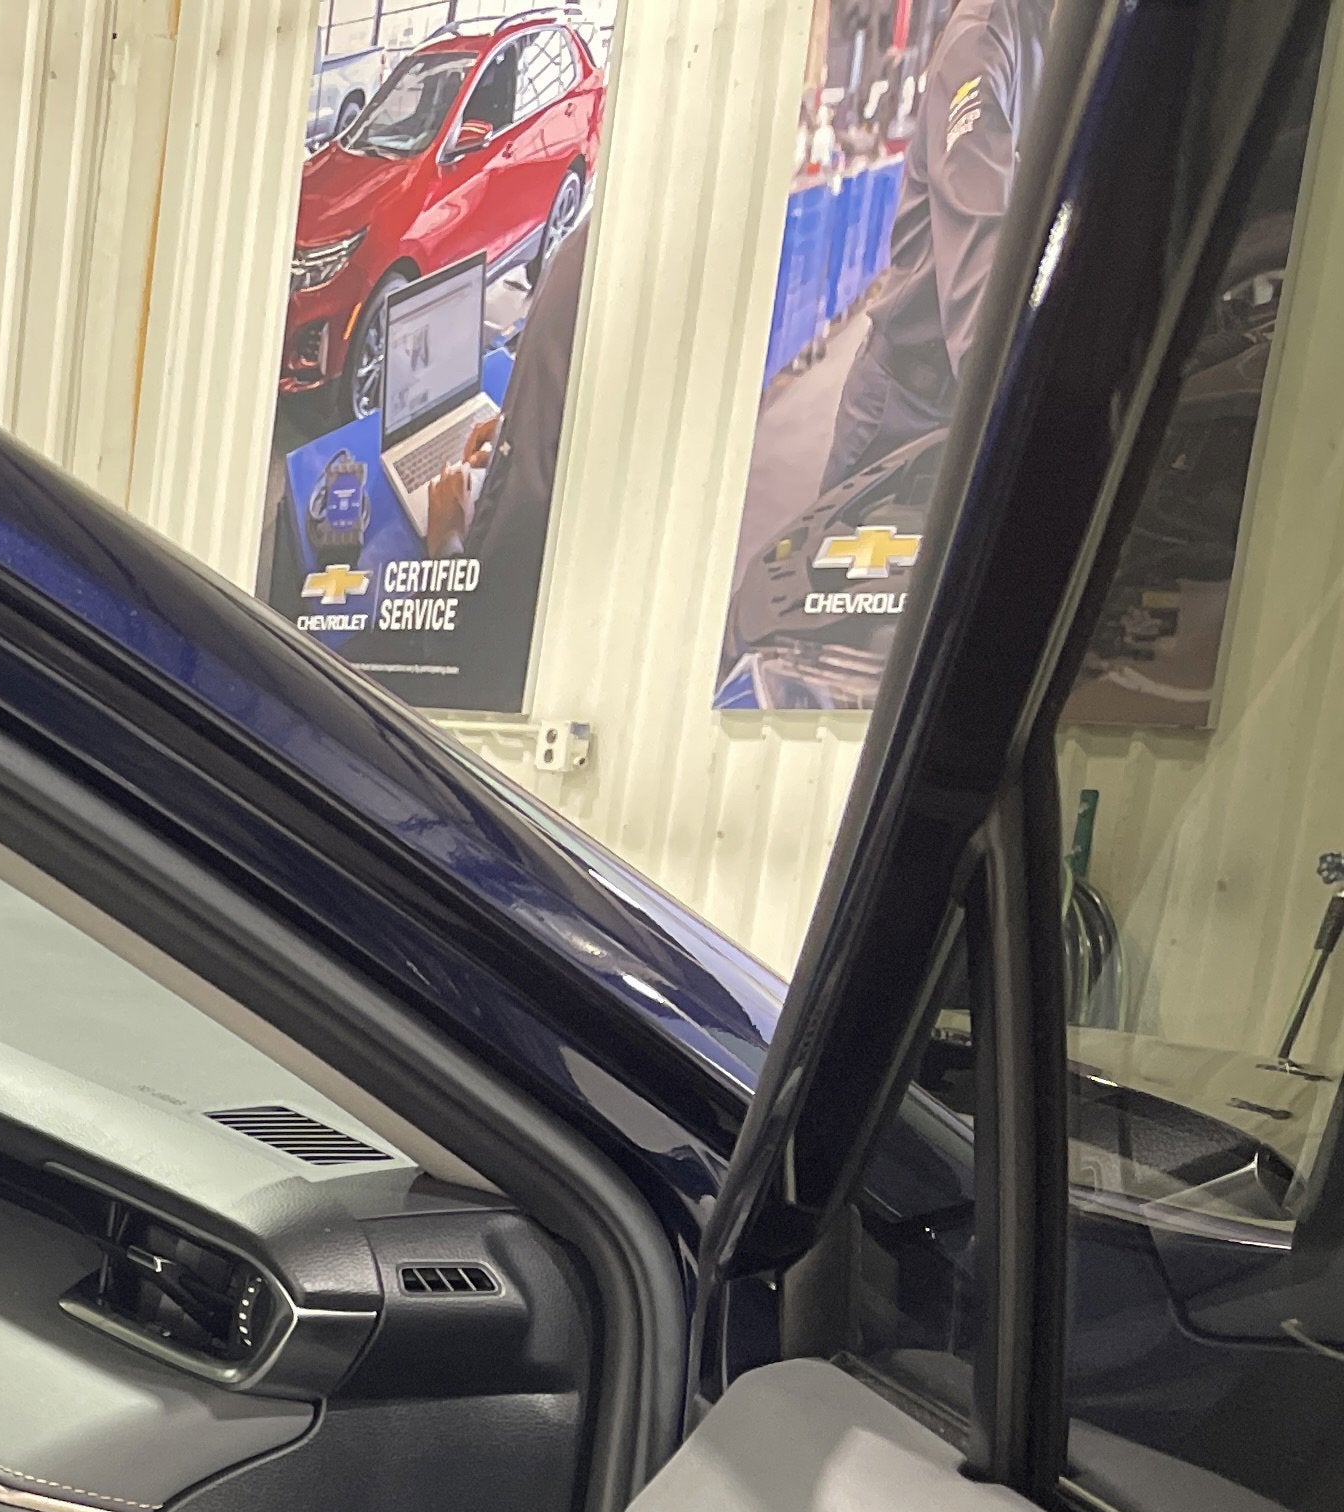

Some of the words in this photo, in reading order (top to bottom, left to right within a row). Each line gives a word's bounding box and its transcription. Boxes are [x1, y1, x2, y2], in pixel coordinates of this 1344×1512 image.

[384, 559, 481, 593] CERTIFIED
[297, 615, 368, 631] CHEVROLET
[379, 598, 459, 631] SERVICE
